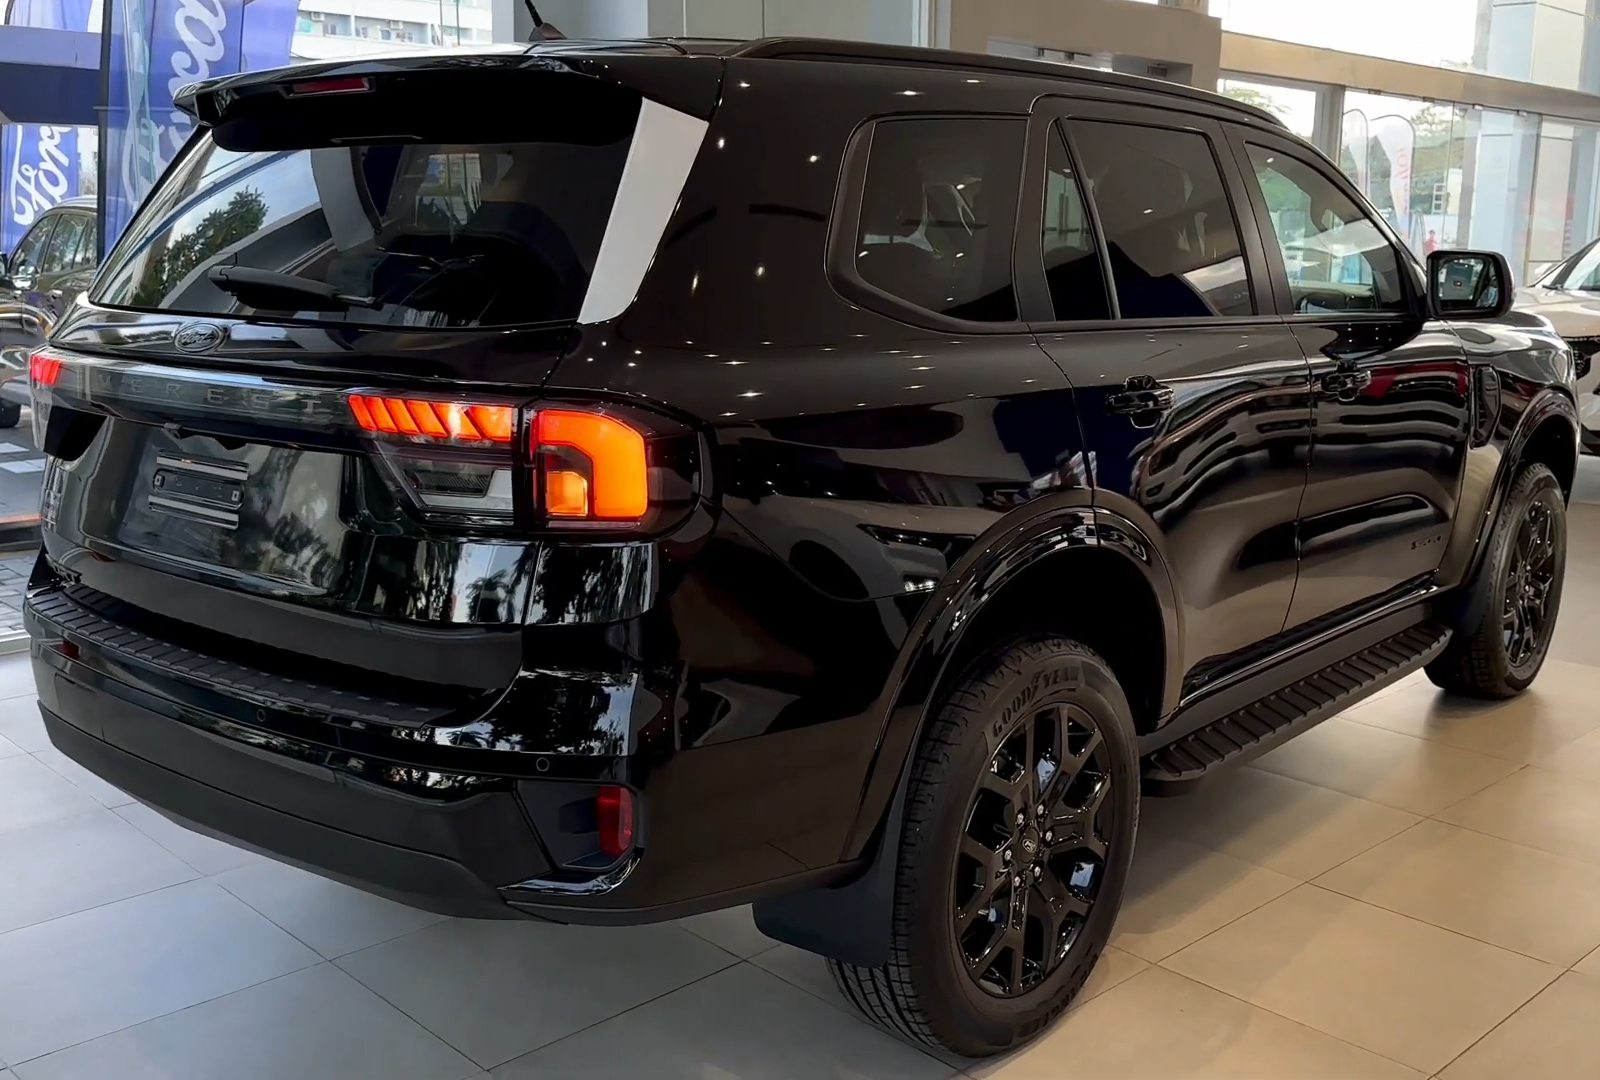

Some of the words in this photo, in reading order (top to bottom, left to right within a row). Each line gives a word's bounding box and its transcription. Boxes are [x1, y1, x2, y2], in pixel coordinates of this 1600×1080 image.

[10, 125, 73, 226] For
[176, 328, 217, 347] Ford
[86, 371, 323, 414] VEREST
